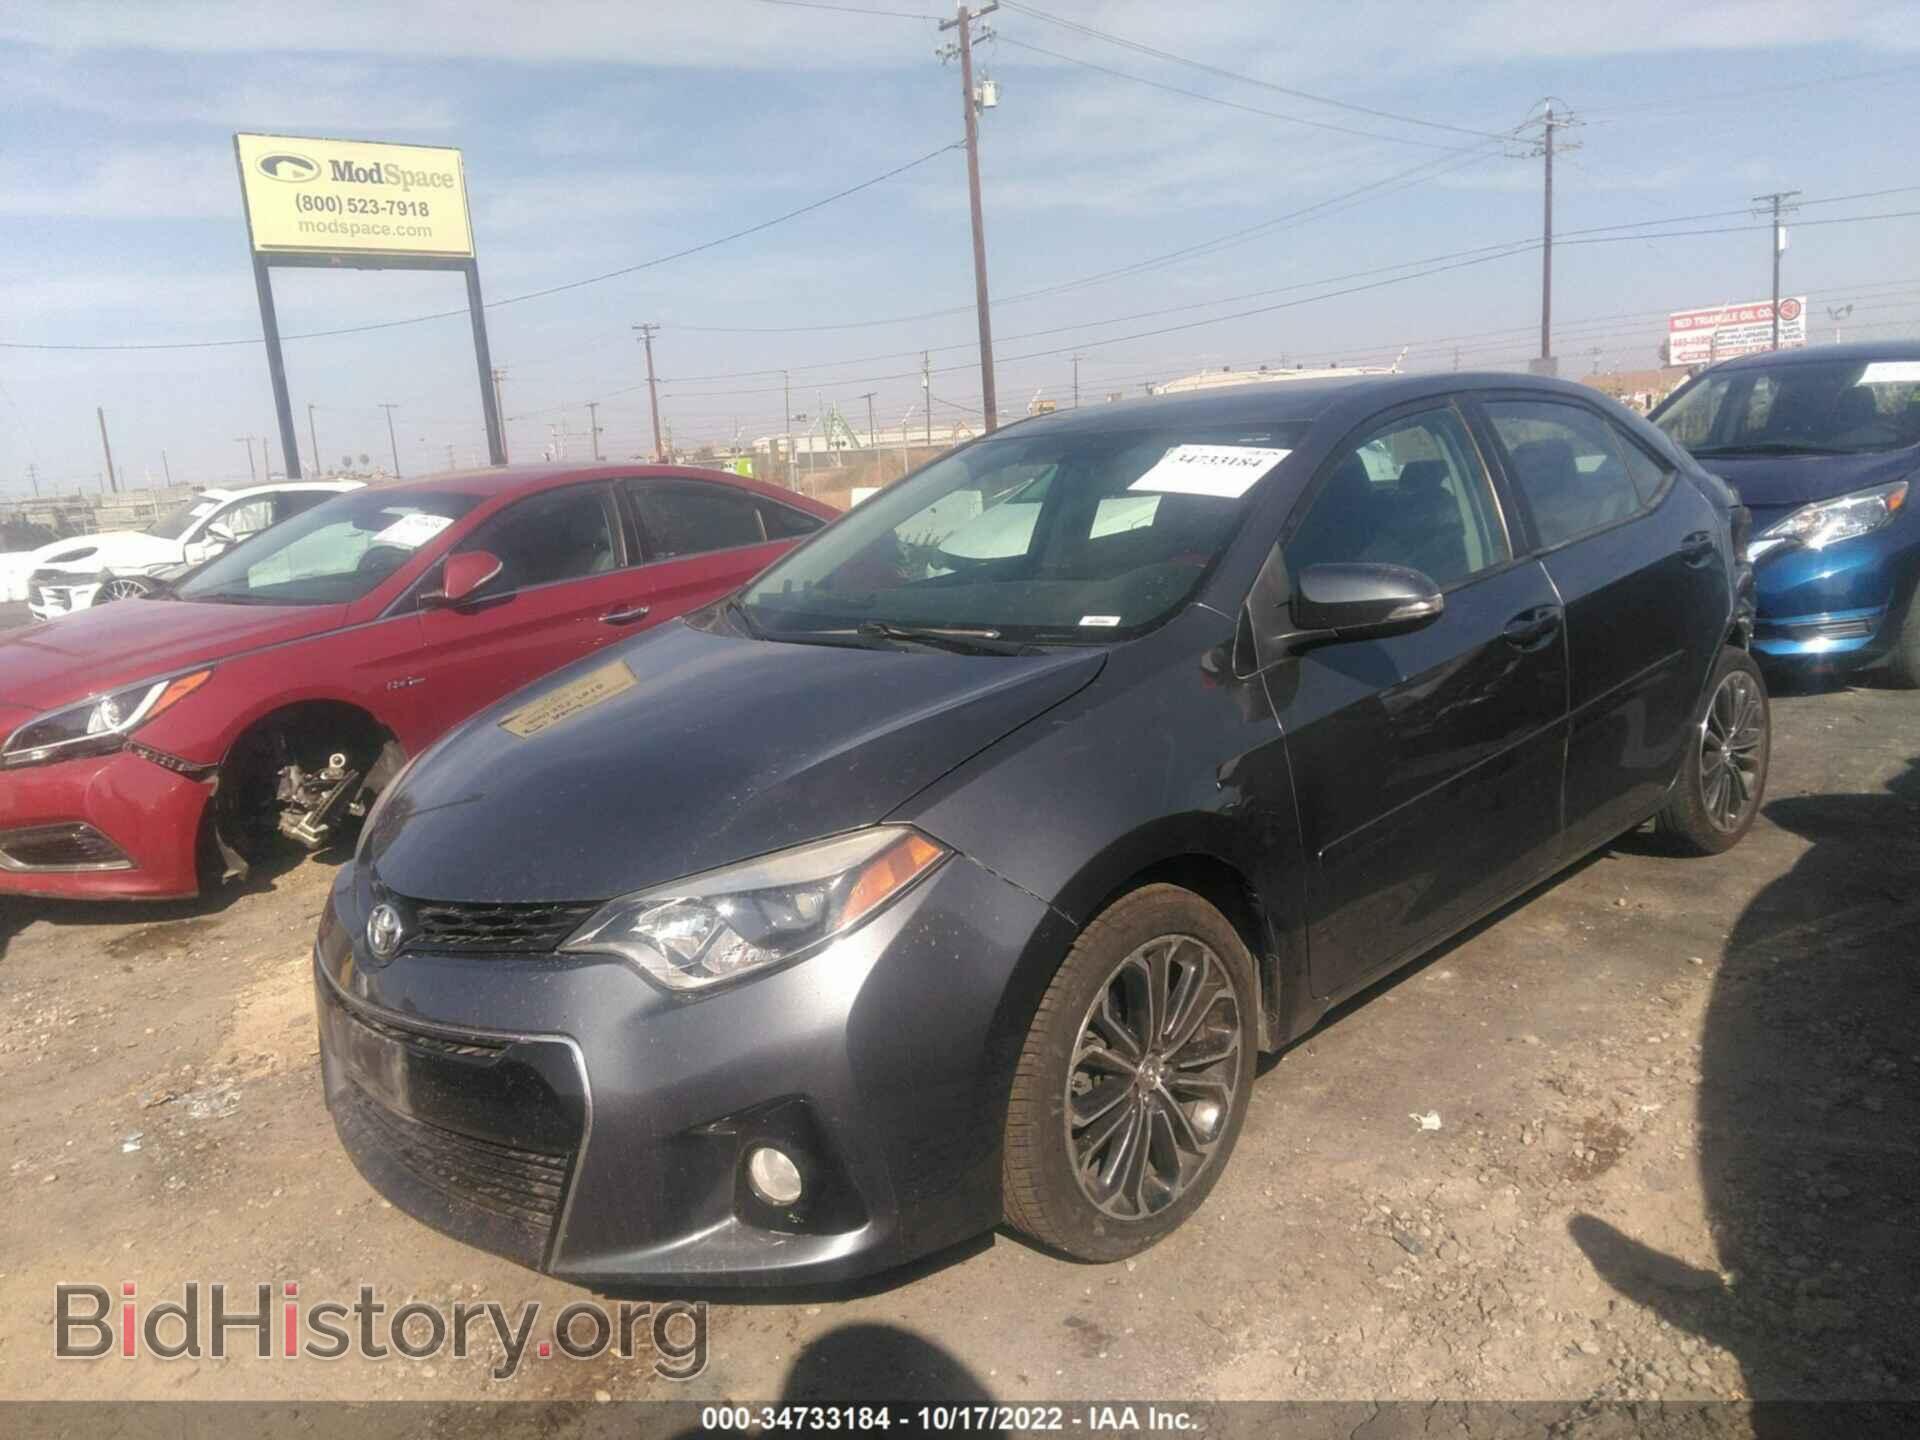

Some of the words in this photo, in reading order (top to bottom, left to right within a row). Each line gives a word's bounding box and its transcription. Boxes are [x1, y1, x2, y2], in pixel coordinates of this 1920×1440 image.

[328, 159, 454, 192] ModSpace
[295, 192, 343, 215] (800)
[348, 197, 430, 217] 523-7918
[298, 218, 432, 238] modspace.com
[1178, 454, 1263, 468] 34733184
